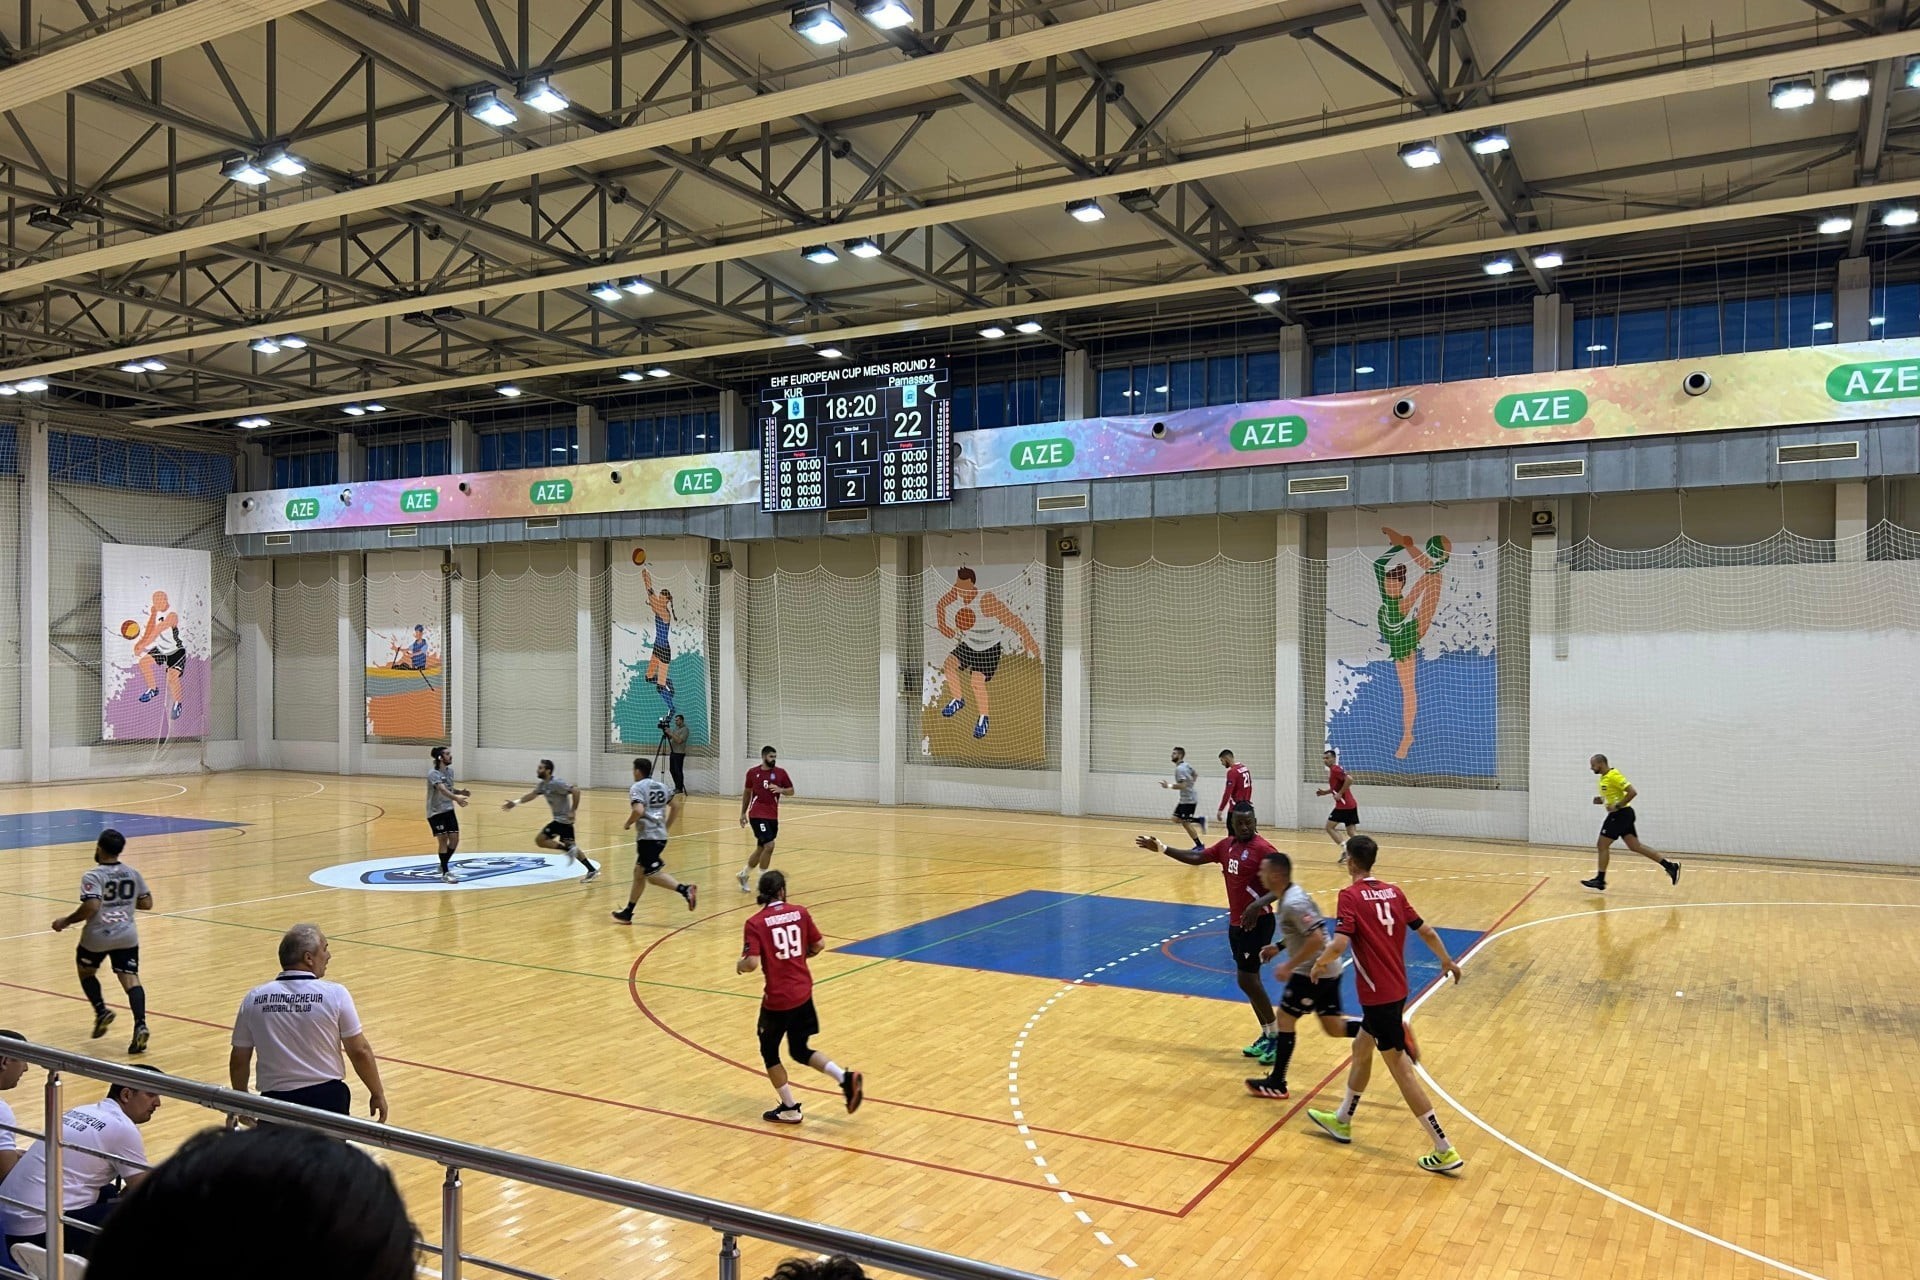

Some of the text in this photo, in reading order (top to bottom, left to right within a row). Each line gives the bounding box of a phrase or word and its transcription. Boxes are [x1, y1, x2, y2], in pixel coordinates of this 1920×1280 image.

[771, 358, 936, 387] EHF EUROPEAN CUP MENS ROUND 2
[1844, 366, 1919, 395] AZE
[784, 388, 803, 398] KUR
[826, 395, 877, 420] 18:20
[1509, 396, 1571, 423] AZE
[894, 411, 922, 438] 22
[782, 423, 809, 448] 29
[1242, 422, 1294, 446] AZE
[834, 438, 868, 457] 1 1
[1020, 444, 1063, 466] AZE
[780, 459, 821, 472] 00 00:00
[883, 450, 928, 464] 00 00:00
[780, 471, 821, 484] 00 00:00
[883, 462, 928, 476] 00 00:00
[681, 472, 713, 491] AZE
[846, 481, 856, 497] 2
[883, 476, 928, 490] 00 00:00
[536, 484, 565, 500] AZE
[780, 484, 821, 498] 00 00:00
[883, 488, 928, 502] 00 00:00
[291, 501, 314, 517] AZE
[406, 493, 432, 509] AZE
[780, 496, 821, 509] 00 00:00
[103, 880, 135, 901] 30
[1375, 902, 1395, 936] 4
[771, 924, 802, 960] 99
